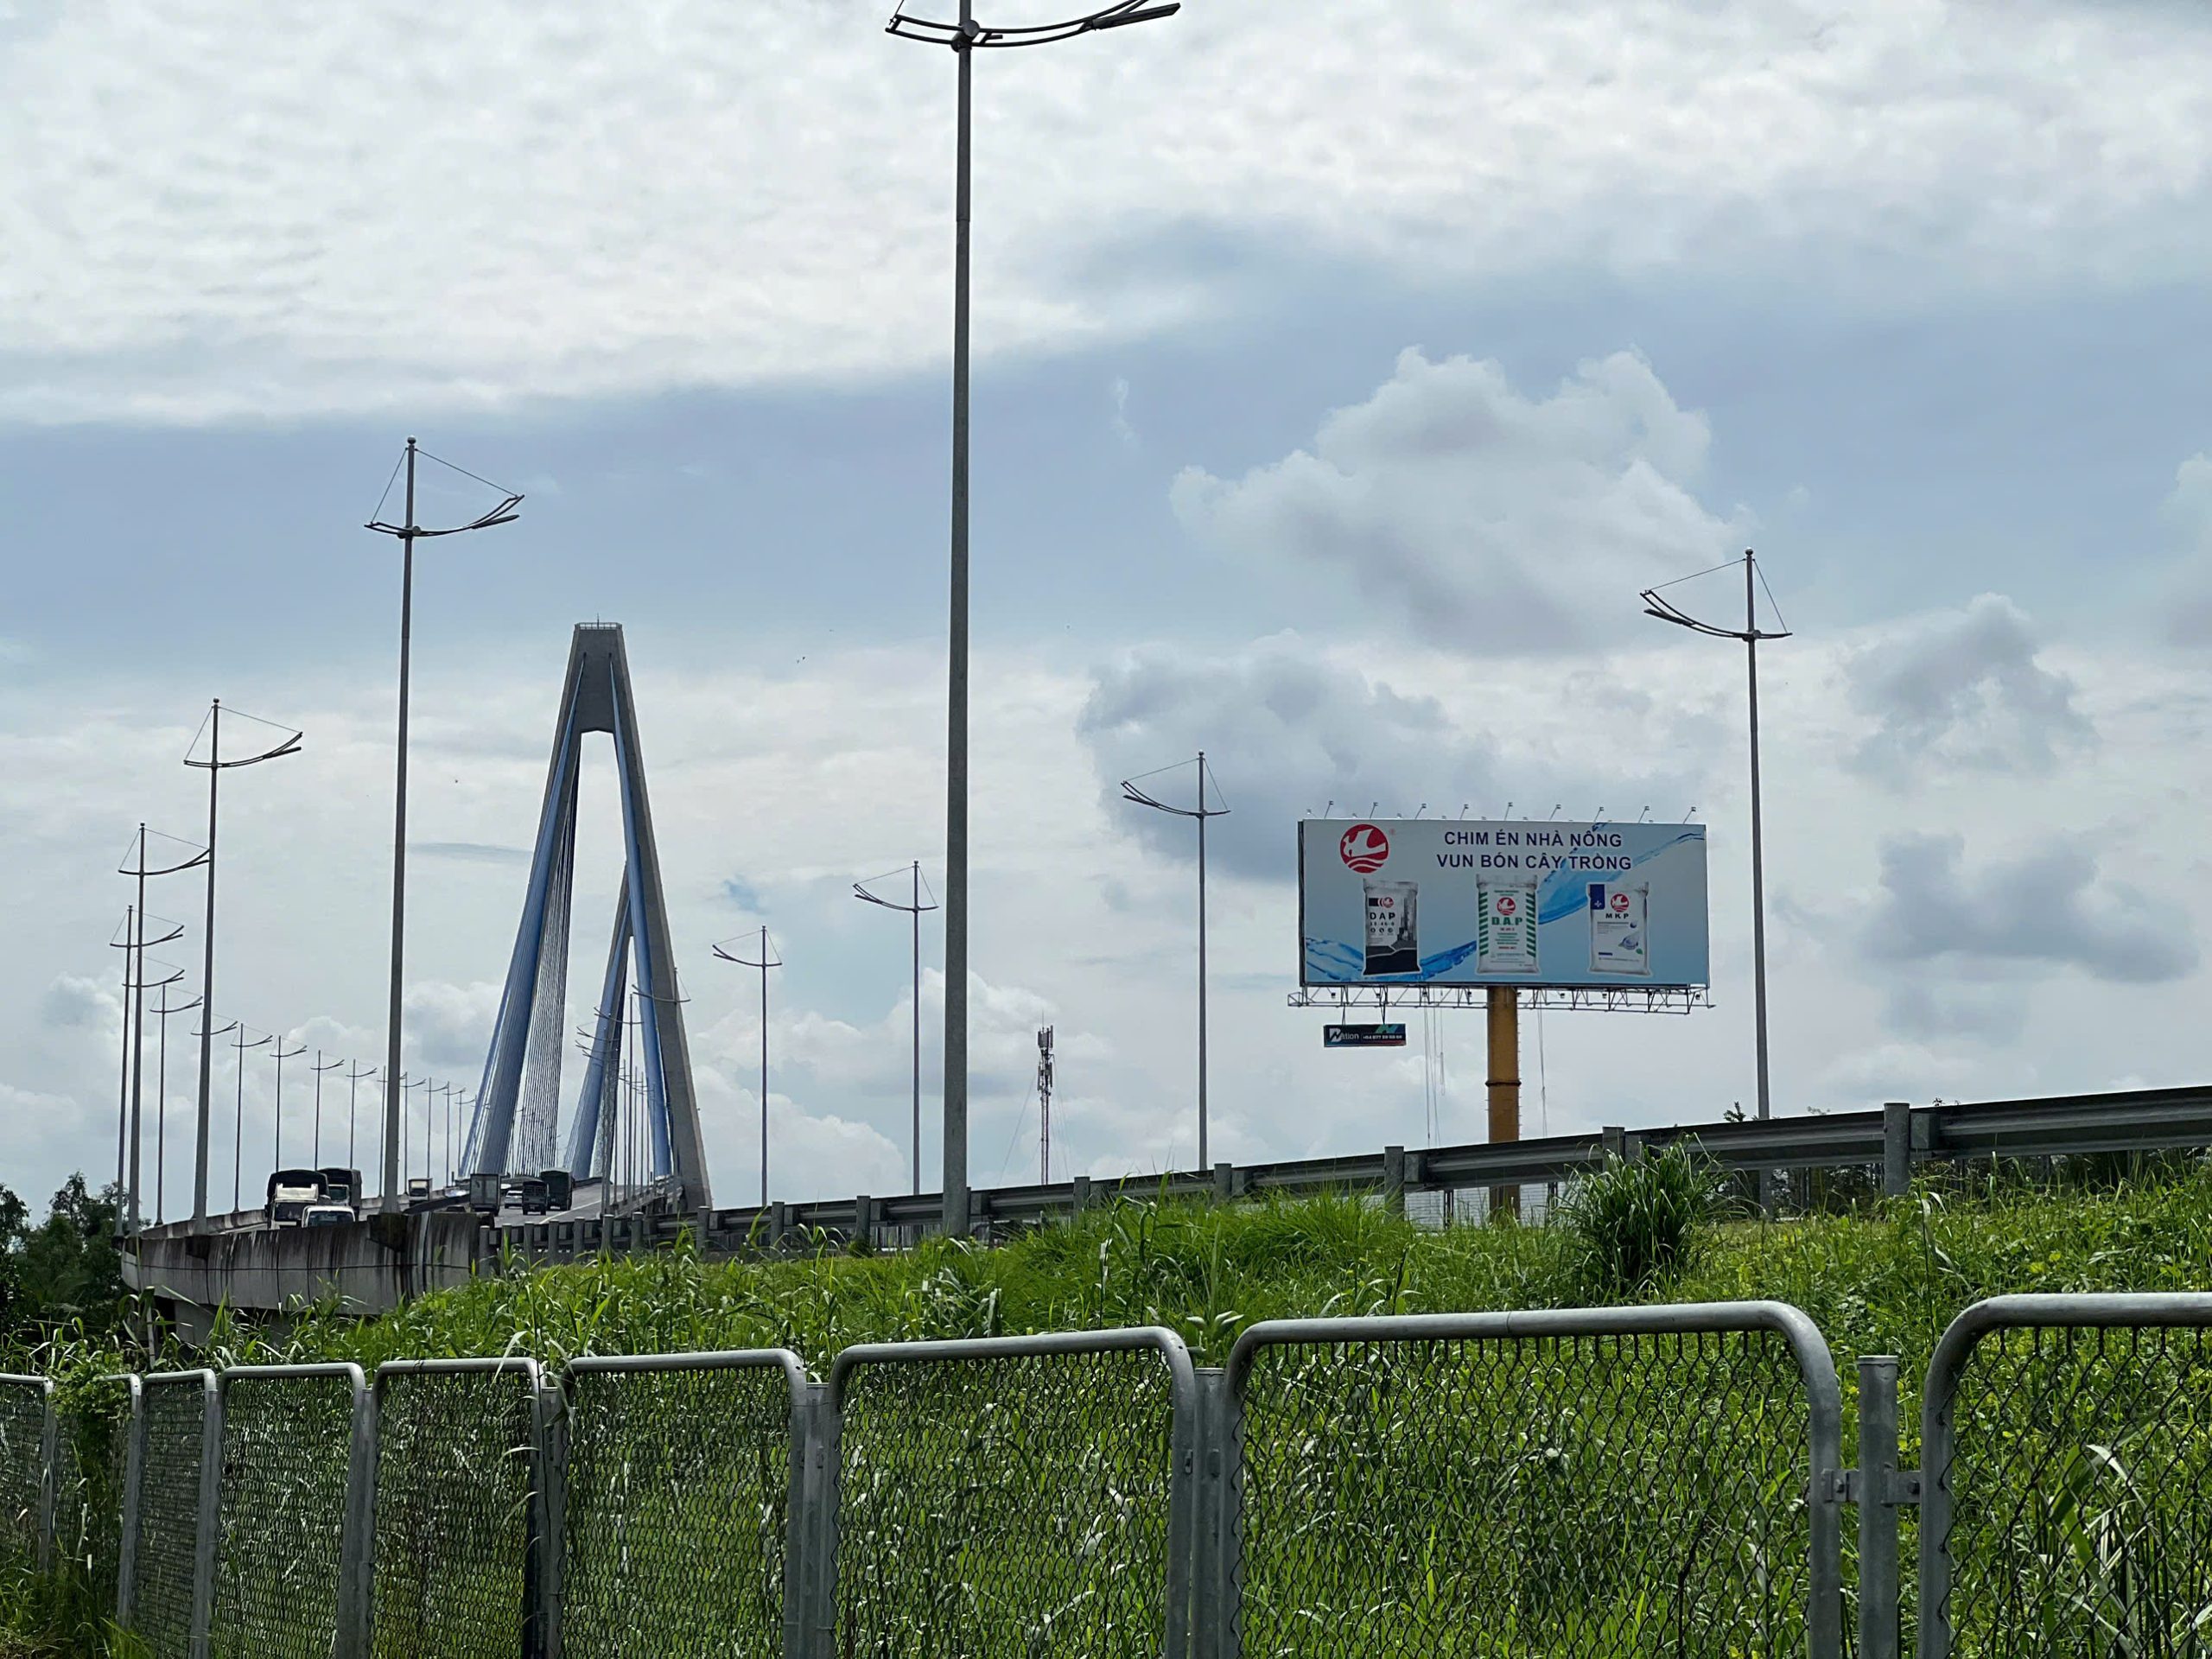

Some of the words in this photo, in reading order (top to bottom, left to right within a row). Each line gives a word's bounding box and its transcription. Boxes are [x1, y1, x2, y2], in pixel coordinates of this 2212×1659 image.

[1445, 831, 1489, 845] CHIM
[1496, 829, 1519, 846] ÉN
[1526, 830, 1564, 847] NHÀ
[1570, 830, 1622, 847] NÔNG
[1436, 854, 1473, 868] VUN
[1481, 851, 1519, 868] BÓN
[1525, 852, 1563, 869] CÂY
